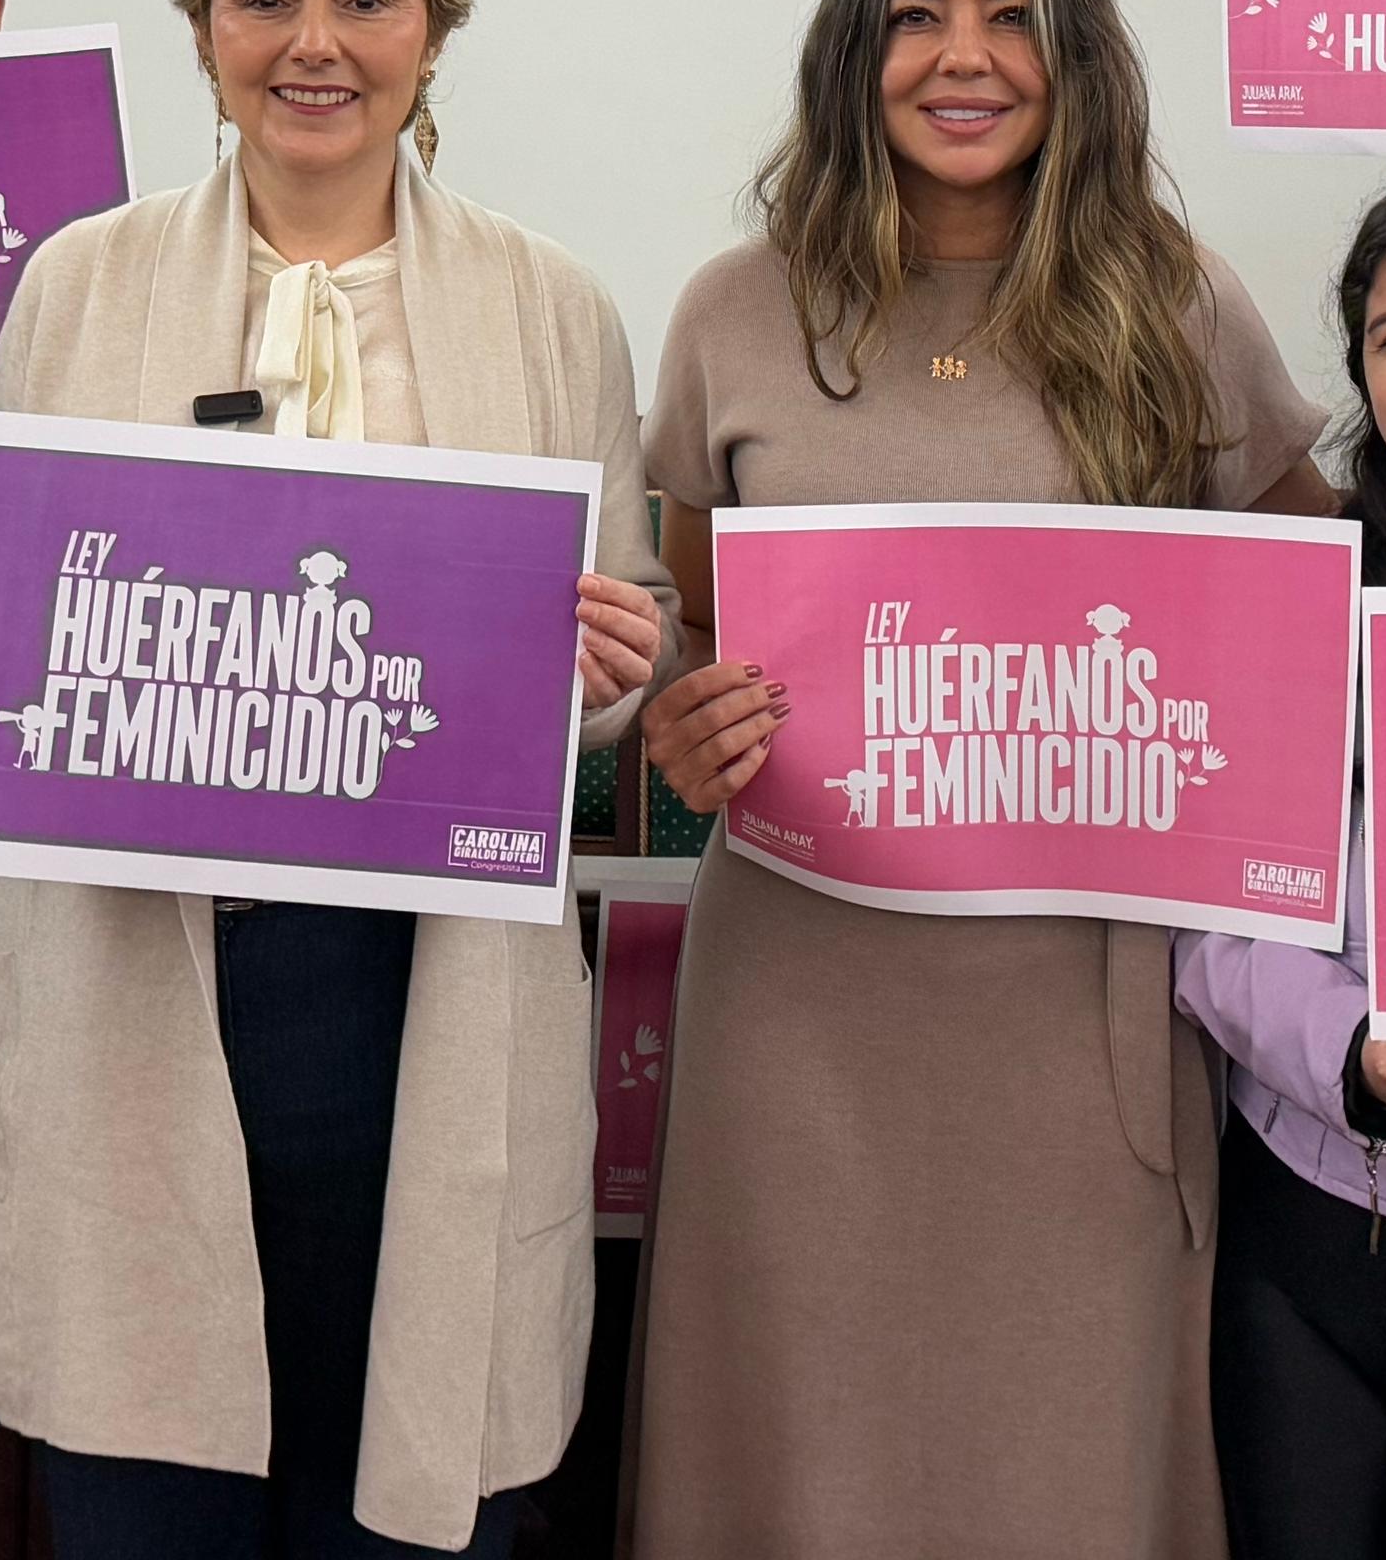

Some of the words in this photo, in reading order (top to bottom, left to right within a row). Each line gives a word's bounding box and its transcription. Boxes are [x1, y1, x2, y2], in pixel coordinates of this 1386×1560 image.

[1242, 84, 1277, 100] JULIANA
[1278, 85, 1304, 101] ARAY.
[60, 529, 116, 577] LEY
[48, 566, 371, 698] HUÉRFANOS
[371, 654, 423, 703] POR
[864, 601, 911, 644] LEY
[863, 628, 1158, 738] HUÉRFANOS
[1162, 698, 1209, 742] POR
[37, 673, 384, 800] FEMINICIDIO
[864, 734, 1179, 831] FEMINICIDIO
[453, 846, 498, 861] GIRALDO
[499, 850, 540, 864] BOTERO
[454, 829, 540, 853] CAROLINA
[783, 830, 815, 851] ARAY.
[1247, 863, 1321, 889] CAROLINA
